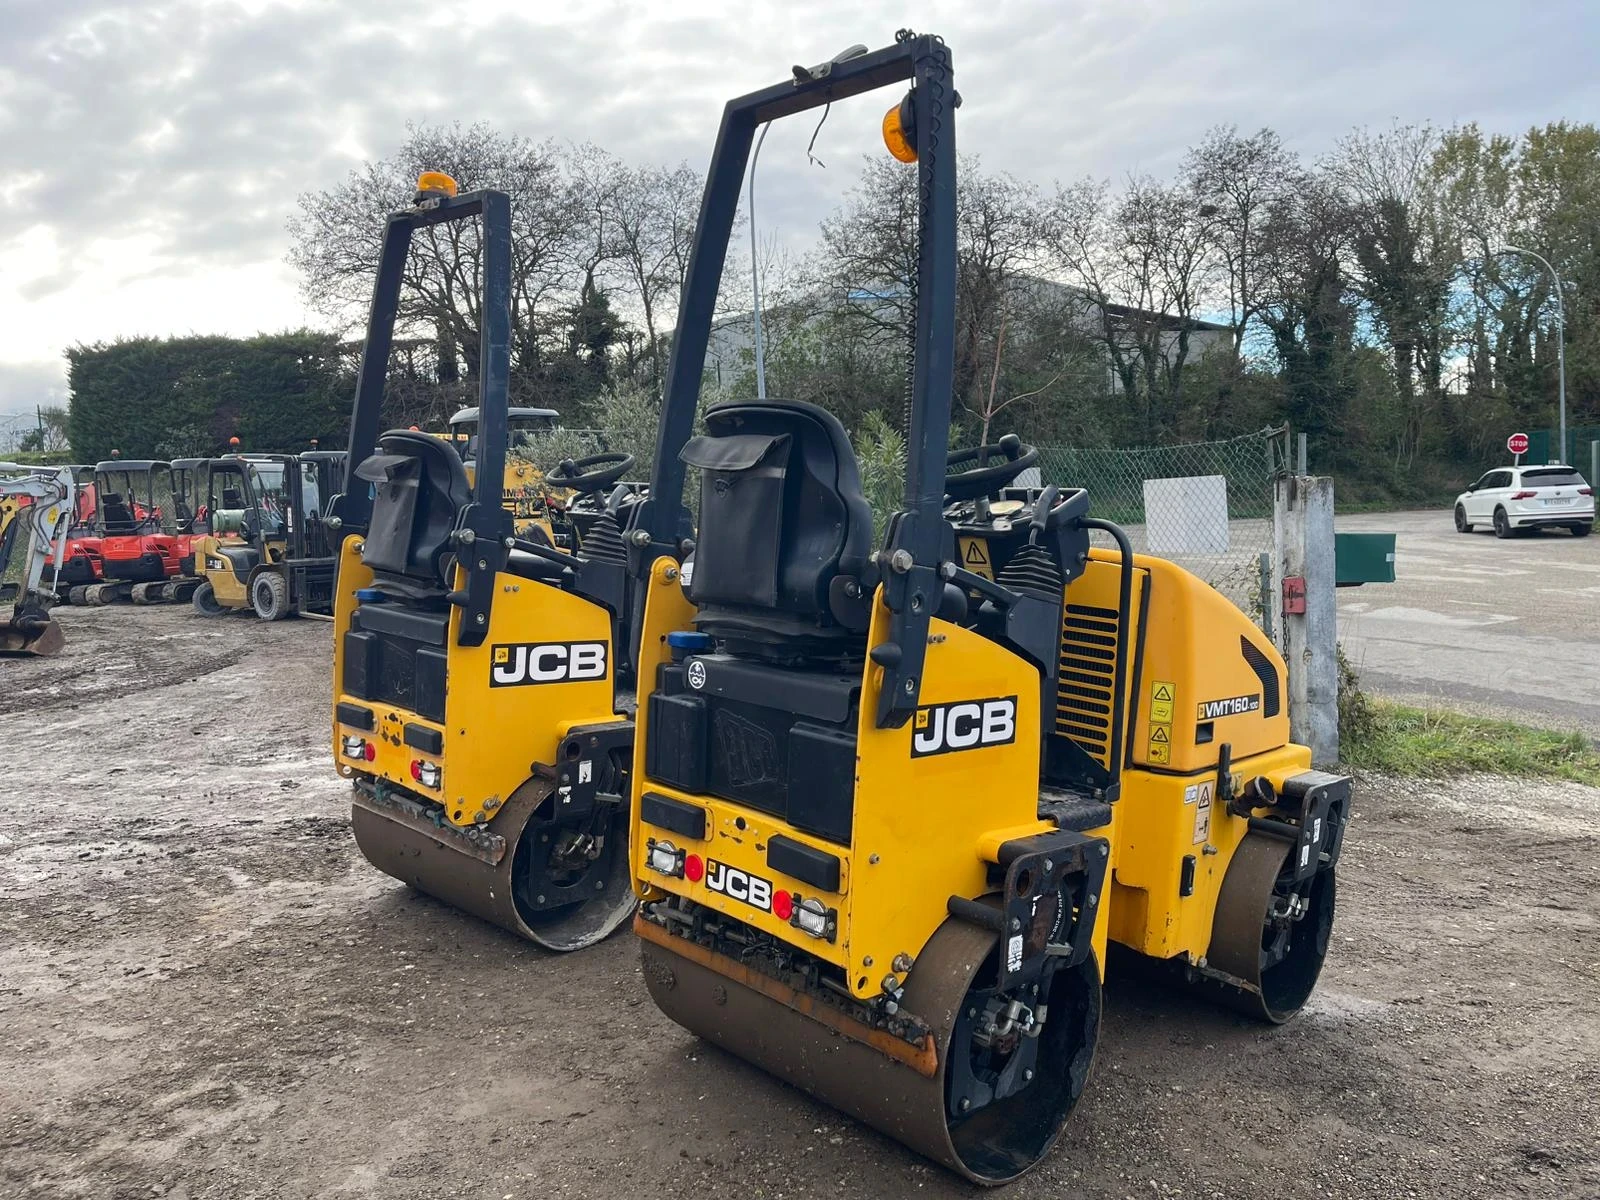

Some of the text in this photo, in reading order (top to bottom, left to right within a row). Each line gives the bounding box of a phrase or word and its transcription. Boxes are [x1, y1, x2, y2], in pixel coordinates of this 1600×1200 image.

[494, 643, 606, 684] JCB
[914, 700, 1015, 753] JCB
[707, 864, 772, 910] JCB
